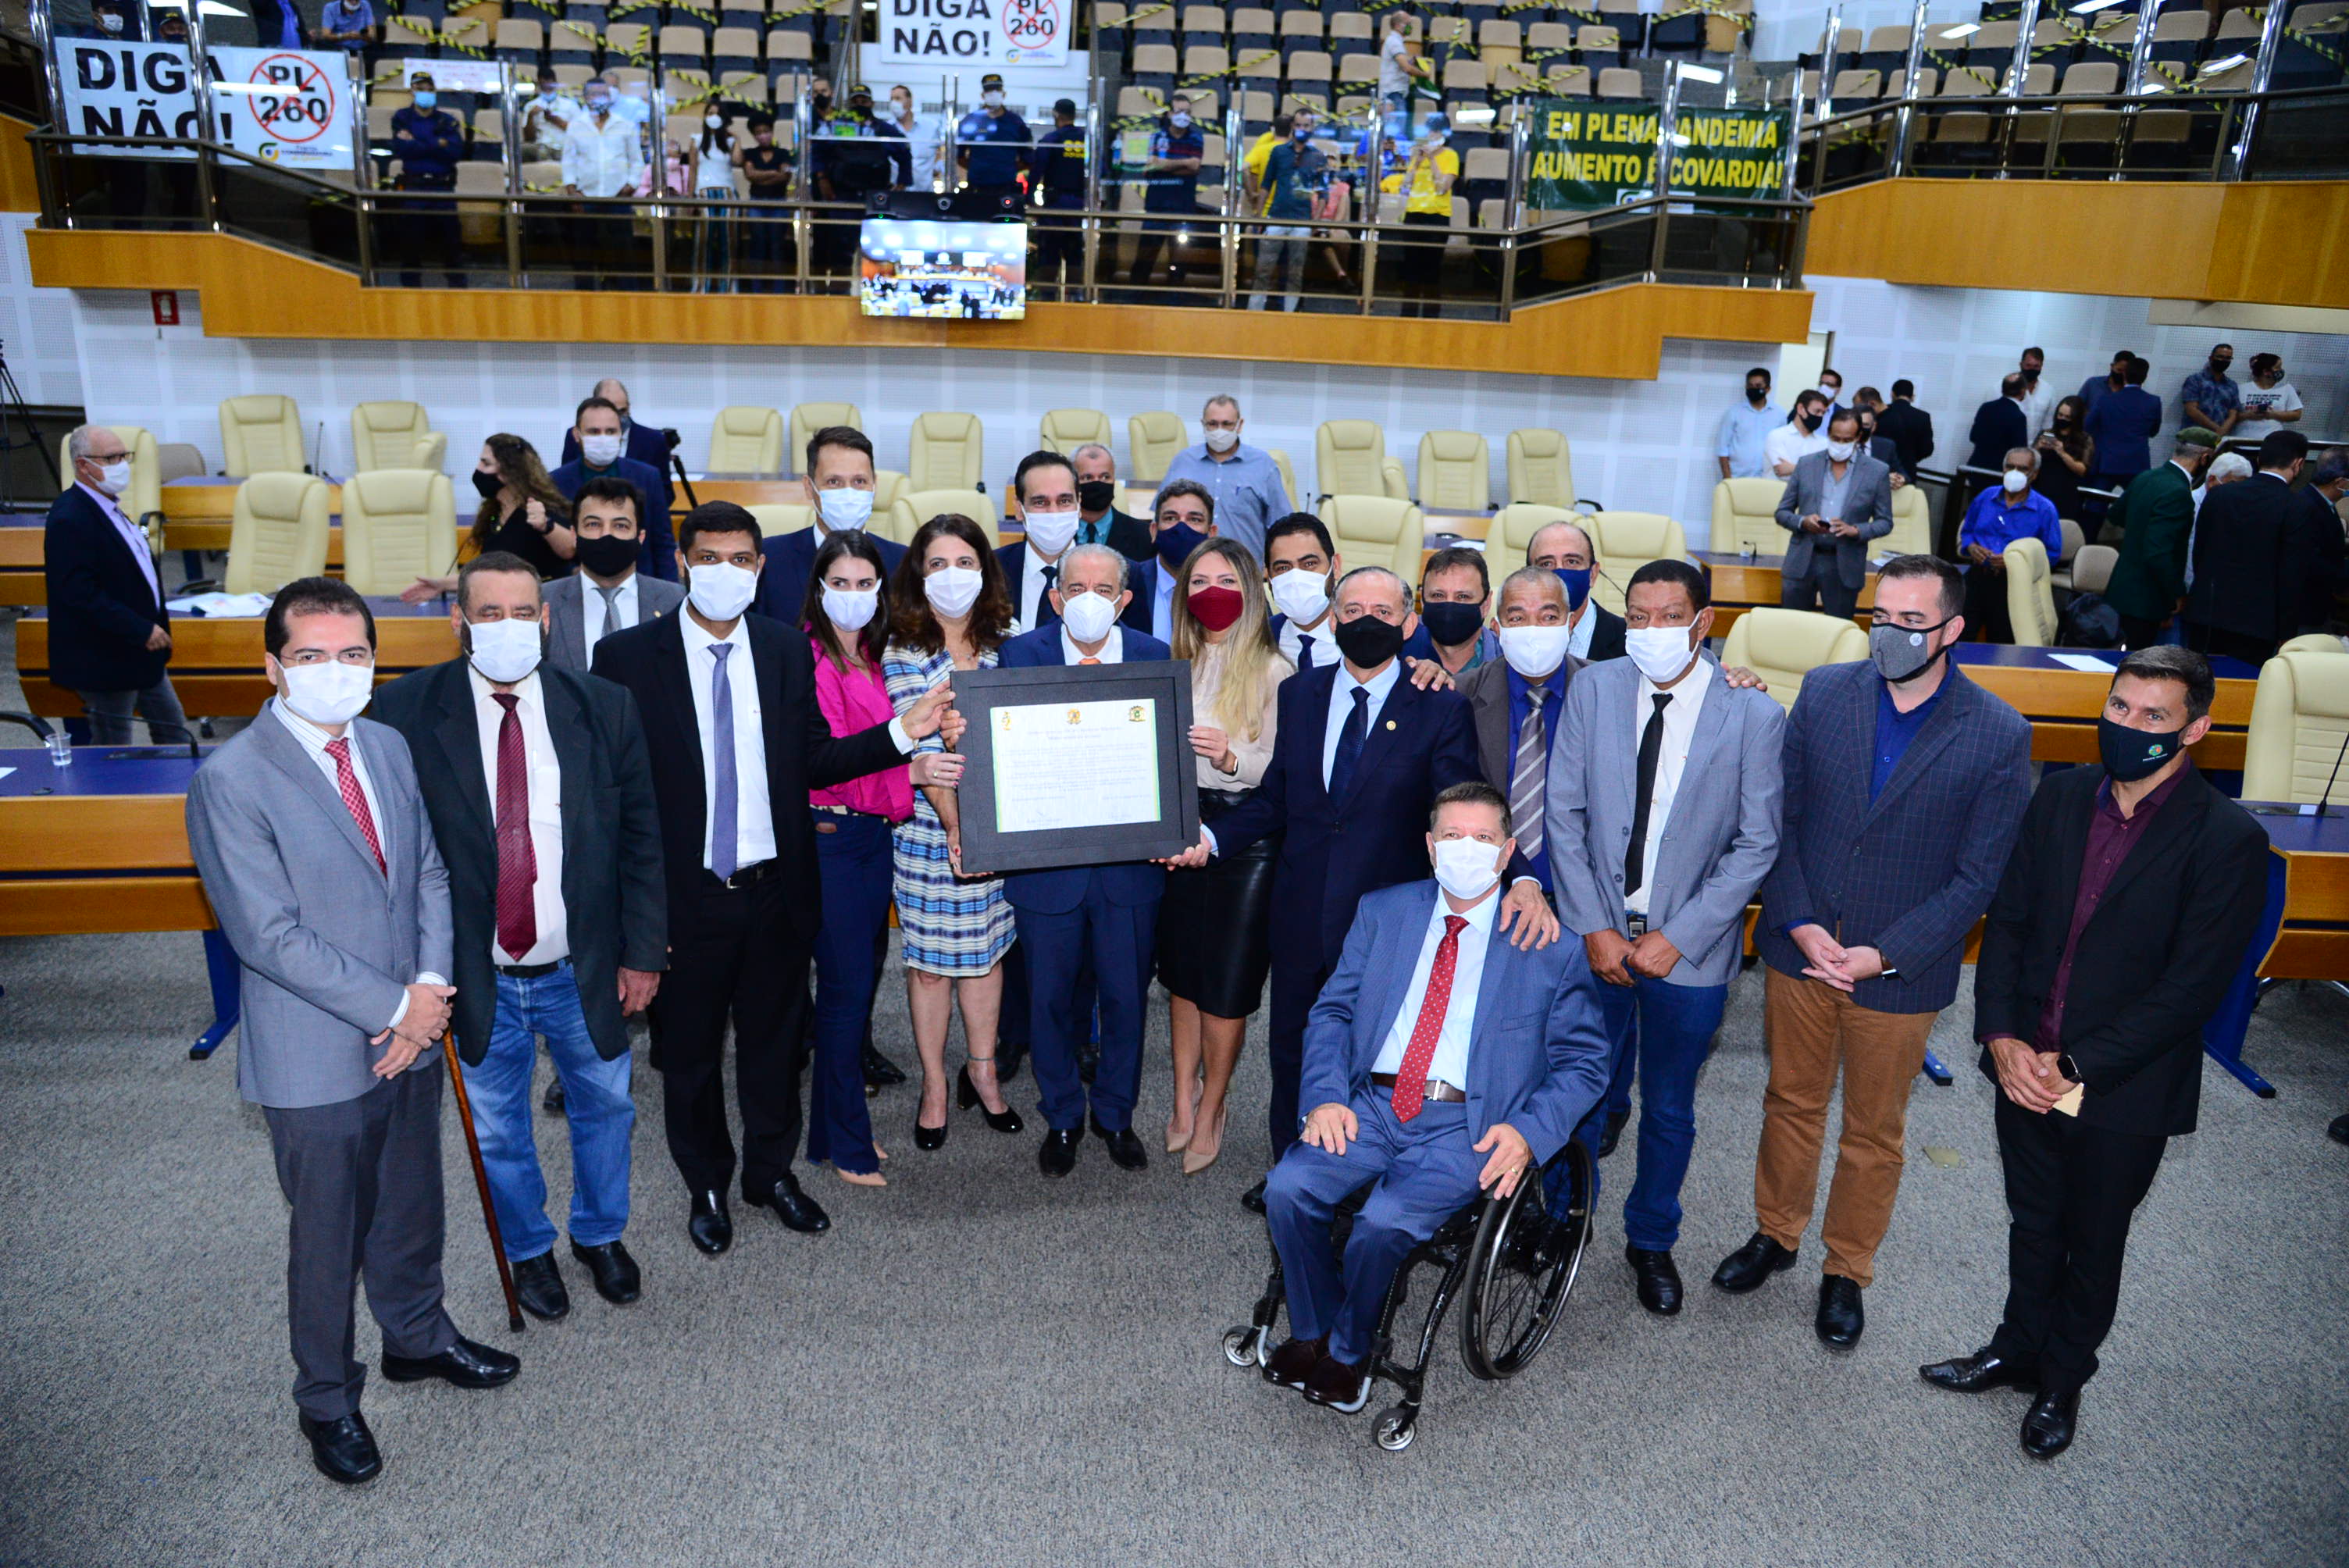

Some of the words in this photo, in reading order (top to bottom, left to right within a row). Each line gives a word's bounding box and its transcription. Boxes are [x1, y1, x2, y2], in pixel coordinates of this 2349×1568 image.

[893, 23, 990, 57] NÃO!
[1010, 19, 1054, 36] 260
[268, 65, 315, 92] PL
[259, 96, 327, 123] 260
[1548, 111, 1582, 141] EM
[1586, 112, 1658, 144] PLENA
[1674, 116, 1778, 149] ANDEMIA
[1531, 151, 1642, 184] AUMENTO
[1669, 157, 1784, 189] COVARDIA!
